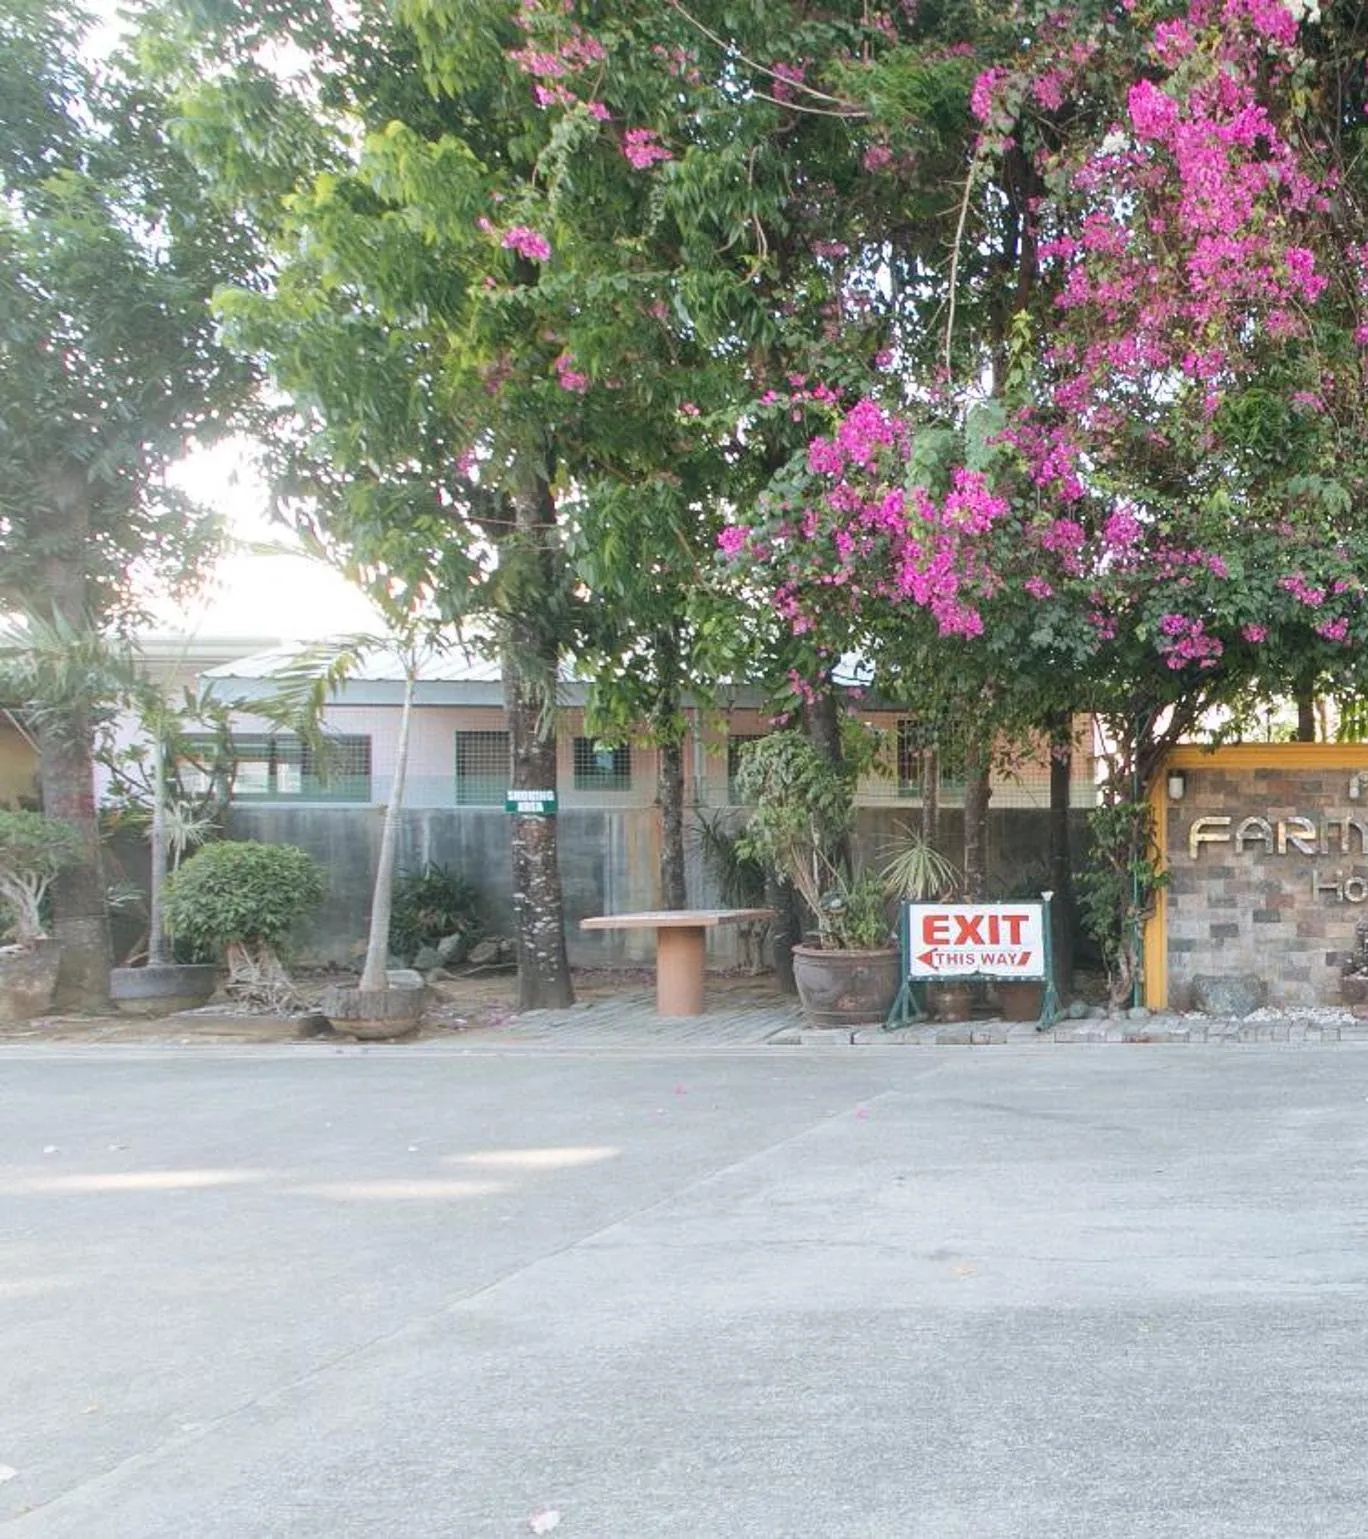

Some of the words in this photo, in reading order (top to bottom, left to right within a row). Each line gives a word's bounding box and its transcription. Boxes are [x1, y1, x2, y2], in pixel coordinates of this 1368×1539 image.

[922, 914, 1030, 946] EXIT
[935, 953, 976, 966] THIS
[980, 953, 1018, 966] WAY
